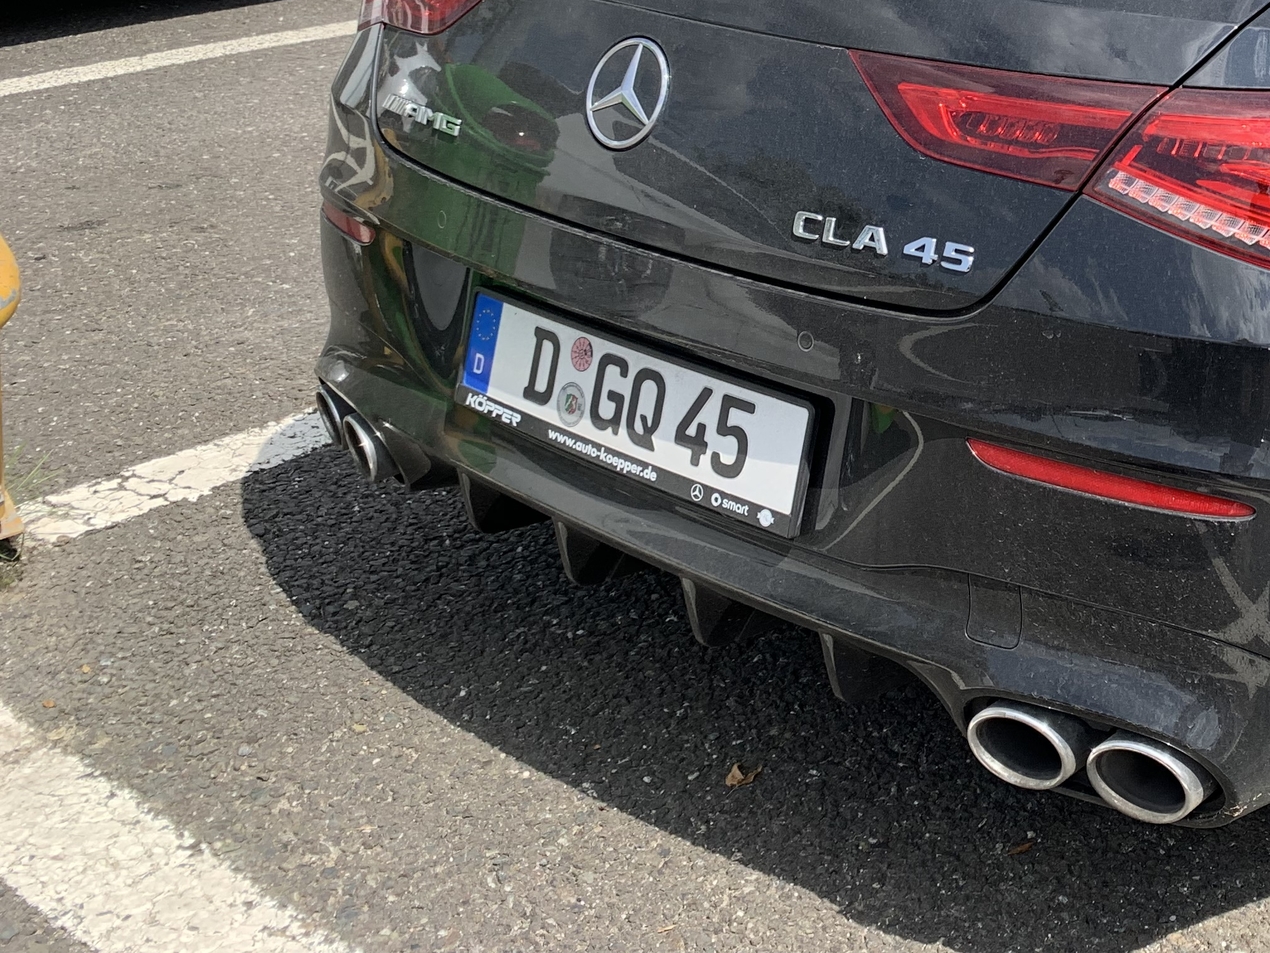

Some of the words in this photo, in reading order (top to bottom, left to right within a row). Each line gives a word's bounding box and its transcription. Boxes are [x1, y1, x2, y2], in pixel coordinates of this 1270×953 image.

[404, 103, 462, 137] AMG
[792, 210, 889, 256] CLA
[903, 236, 975, 273] 45
[473, 352, 485, 374] D
[465, 392, 522, 427] KÖPPER
[522, 326, 560, 406] D
[589, 352, 666, 452] GQ
[674, 386, 756, 479] 45
[547, 428, 658, 483] www.auto-koepper.de
[721, 497, 750, 517] smart
